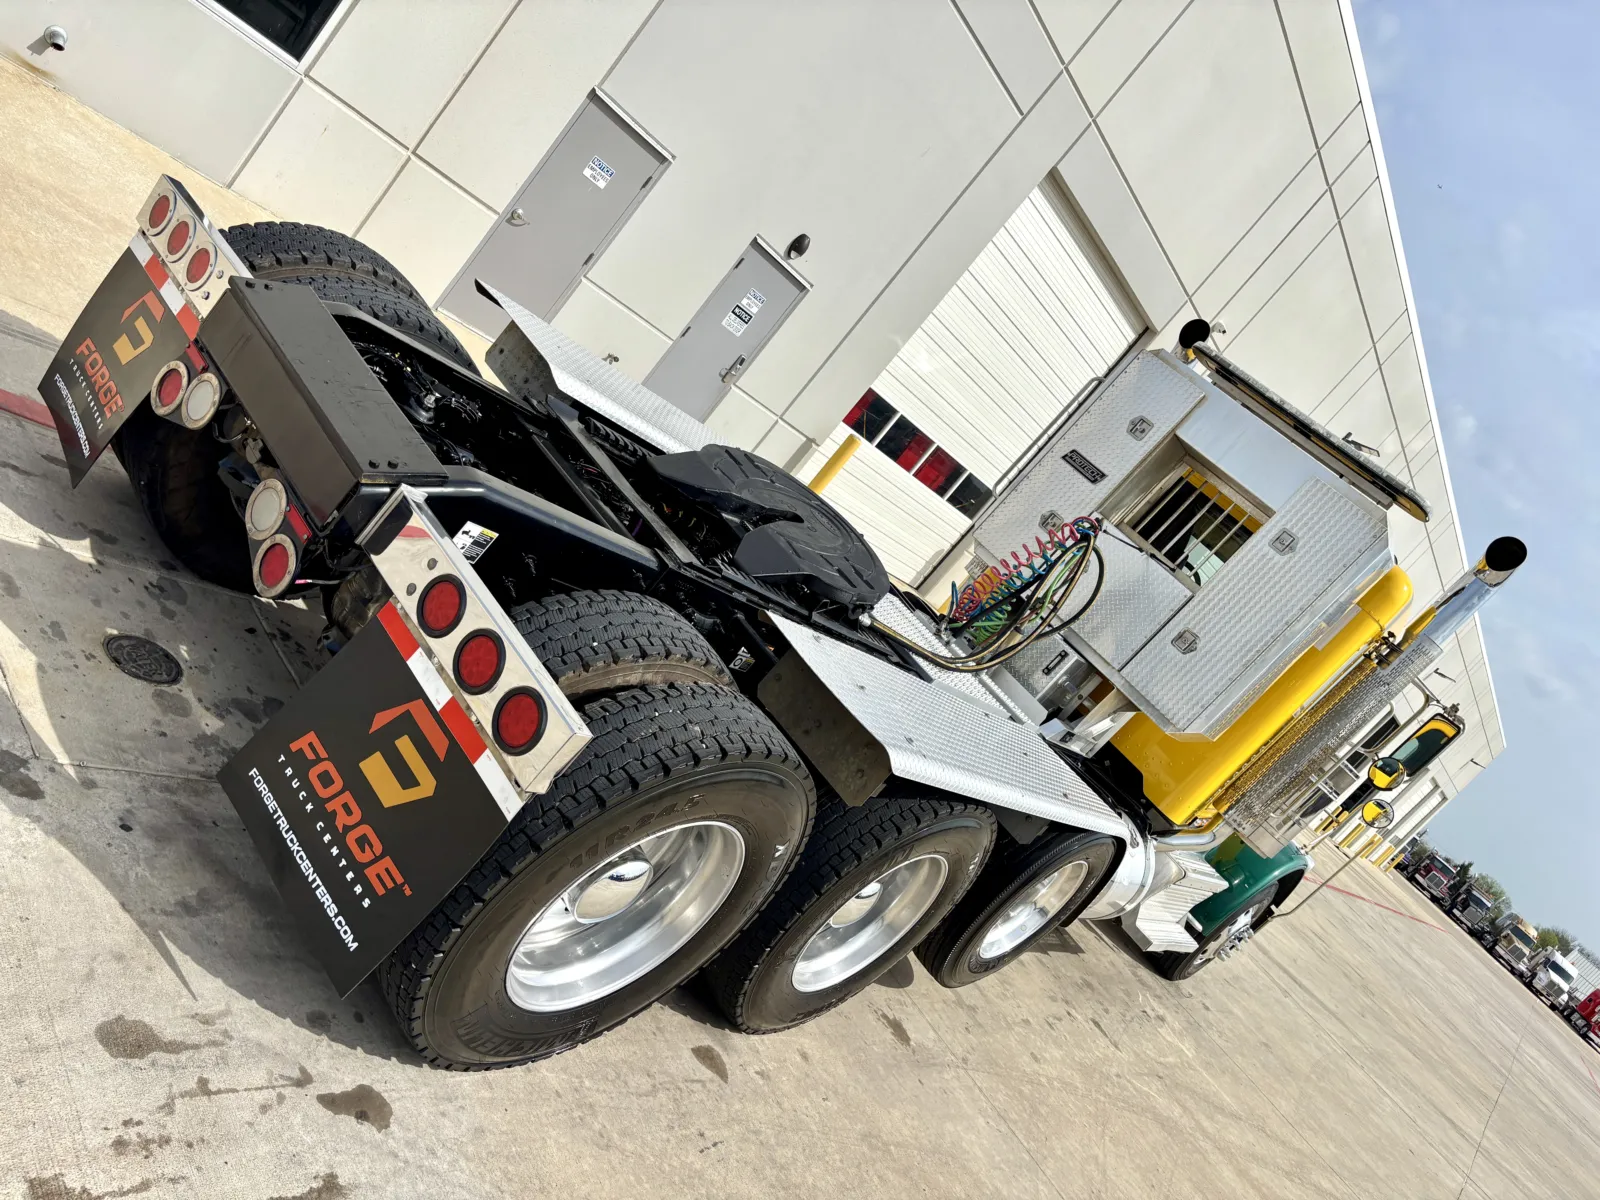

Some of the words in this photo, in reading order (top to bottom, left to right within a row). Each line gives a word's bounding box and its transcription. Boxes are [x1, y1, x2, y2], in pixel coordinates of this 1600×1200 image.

[588, 164, 609, 183] EMPLOYEES
[590, 173, 600, 183] ONLY
[592, 156, 615, 177] NOTICE
[749, 289, 766, 304] NOTICE
[733, 306, 751, 322] NOTICE
[69, 358, 87, 389] TRUCK
[85, 389, 104, 430] CENTERS
[53, 373, 91, 459] FORGETRUCKCENTERS.COM
[1067, 451, 1101, 480] PROTECH
[277, 754, 314, 813] TRUCK
[316, 821, 371, 908] CENTERS
[248, 767, 359, 952] FORGETRUCKCENTERS.COM
